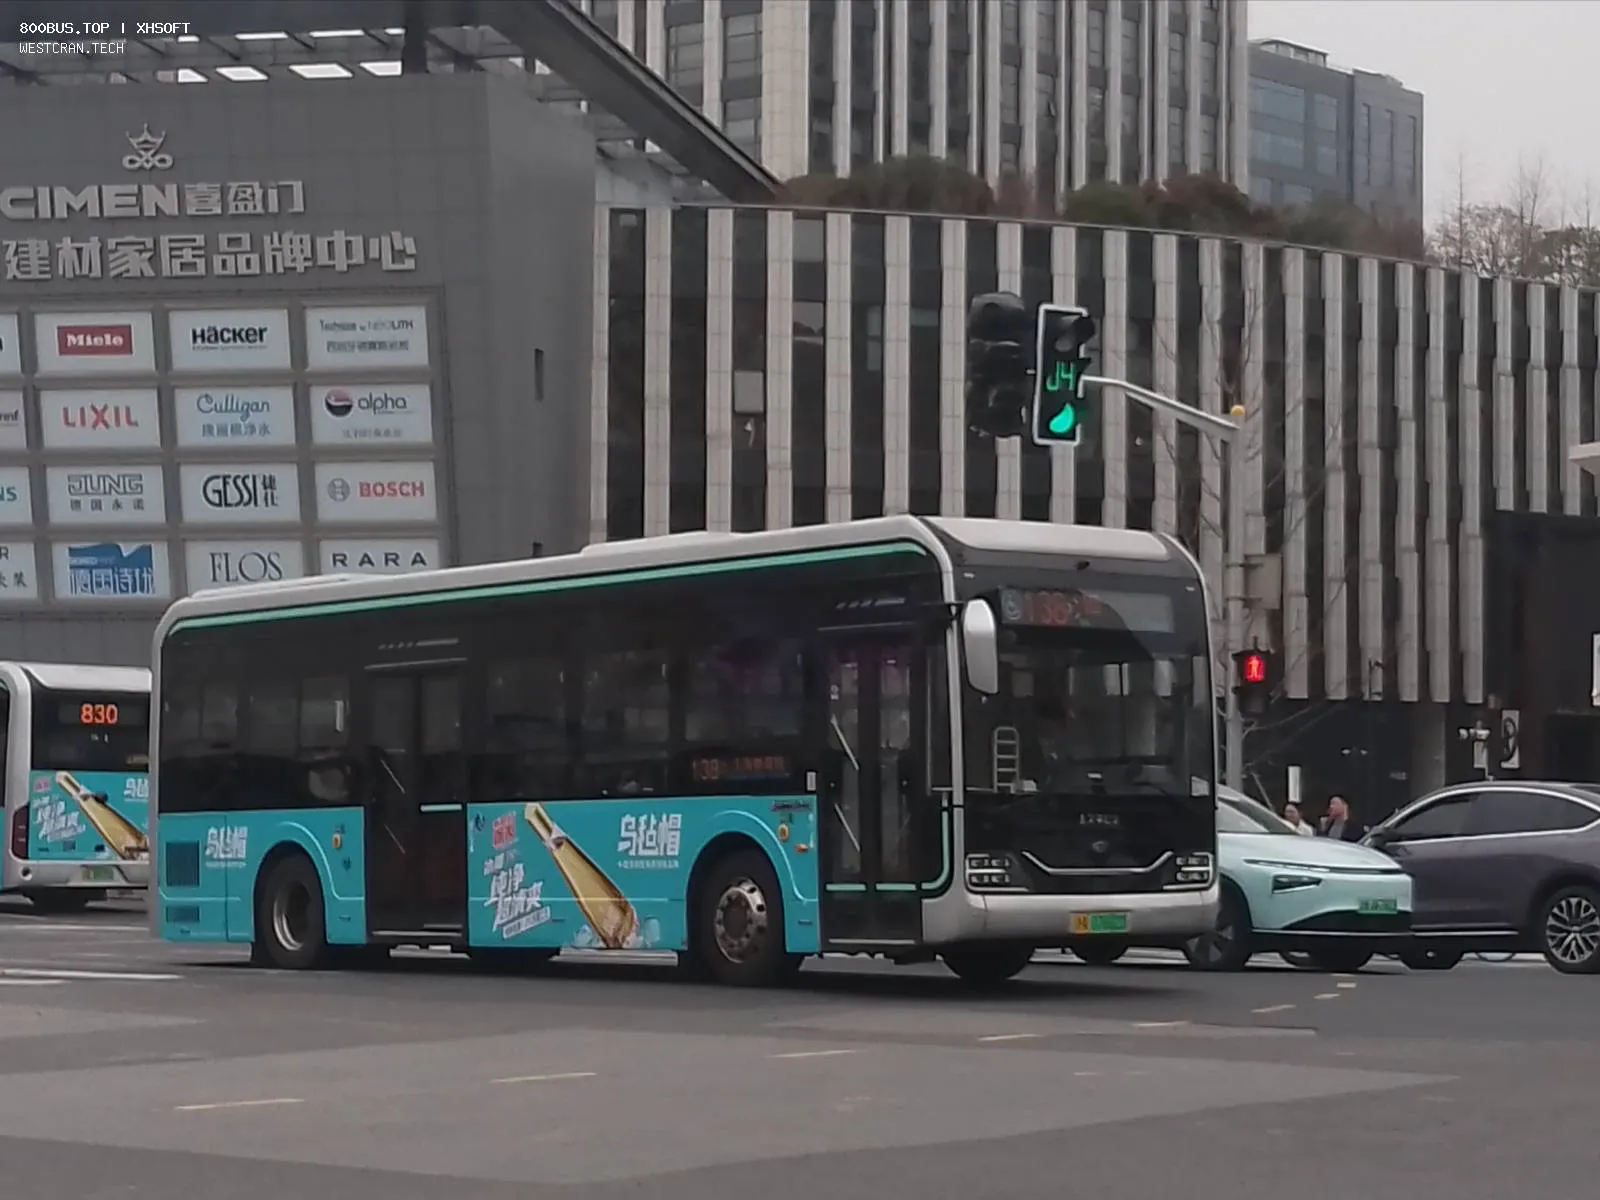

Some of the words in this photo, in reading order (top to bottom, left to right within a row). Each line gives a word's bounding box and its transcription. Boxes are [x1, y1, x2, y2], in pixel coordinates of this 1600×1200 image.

[0, 183, 179, 219] CIMEN
[184, 179, 305, 216] 喜盈门
[3, 229, 417, 281] 建材家居品牌中心
[66, 333, 124, 347] Miele
[197, 393, 270, 421] Culligan
[358, 392, 407, 415] alpha
[62, 404, 139, 429] LIXIL
[68, 474, 143, 495] JUNG
[202, 475, 258, 507] GESSI
[360, 482, 425, 498] BOSCH
[210, 552, 283, 582] FLOS
[332, 553, 428, 567] RARA
[80, 703, 118, 723] 830
[617, 813, 682, 856] 乌毡帽
